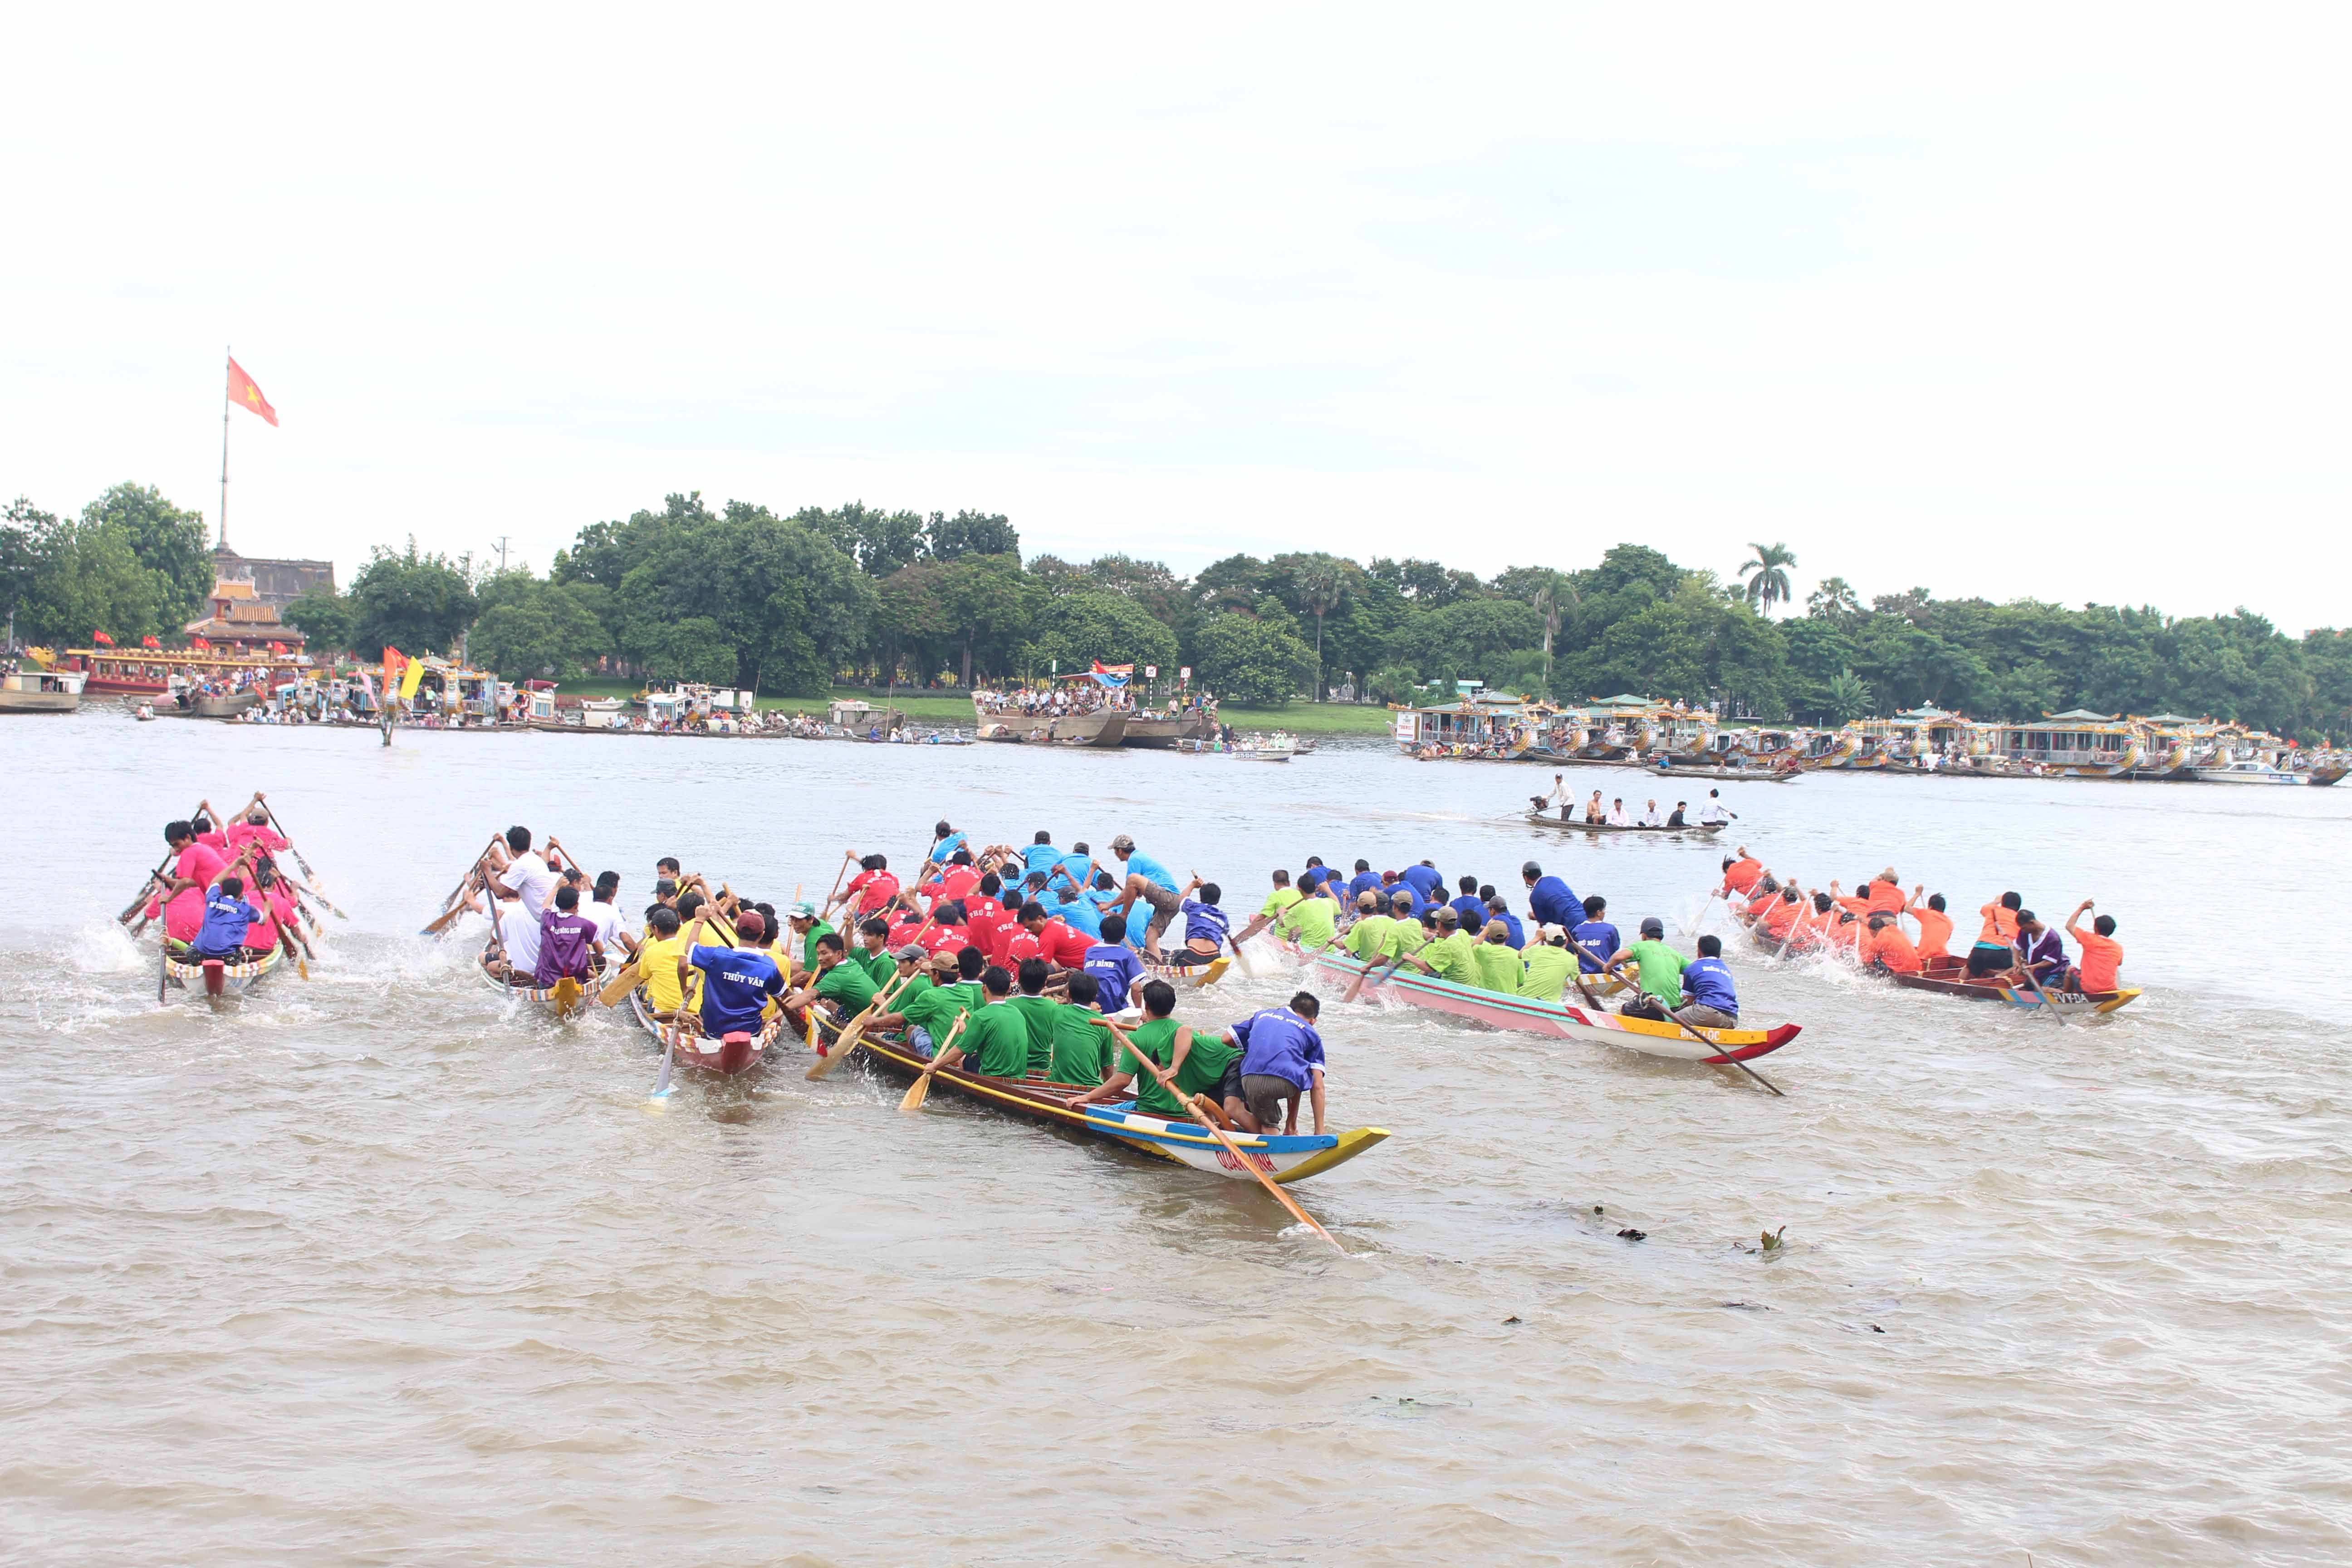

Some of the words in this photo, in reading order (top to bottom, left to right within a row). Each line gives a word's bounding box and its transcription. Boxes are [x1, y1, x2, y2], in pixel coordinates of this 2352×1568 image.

[722, 971, 746, 983] THỦY
[748, 976, 765, 988] VÂN
[1215, 1151, 1250, 1172] QUAN
